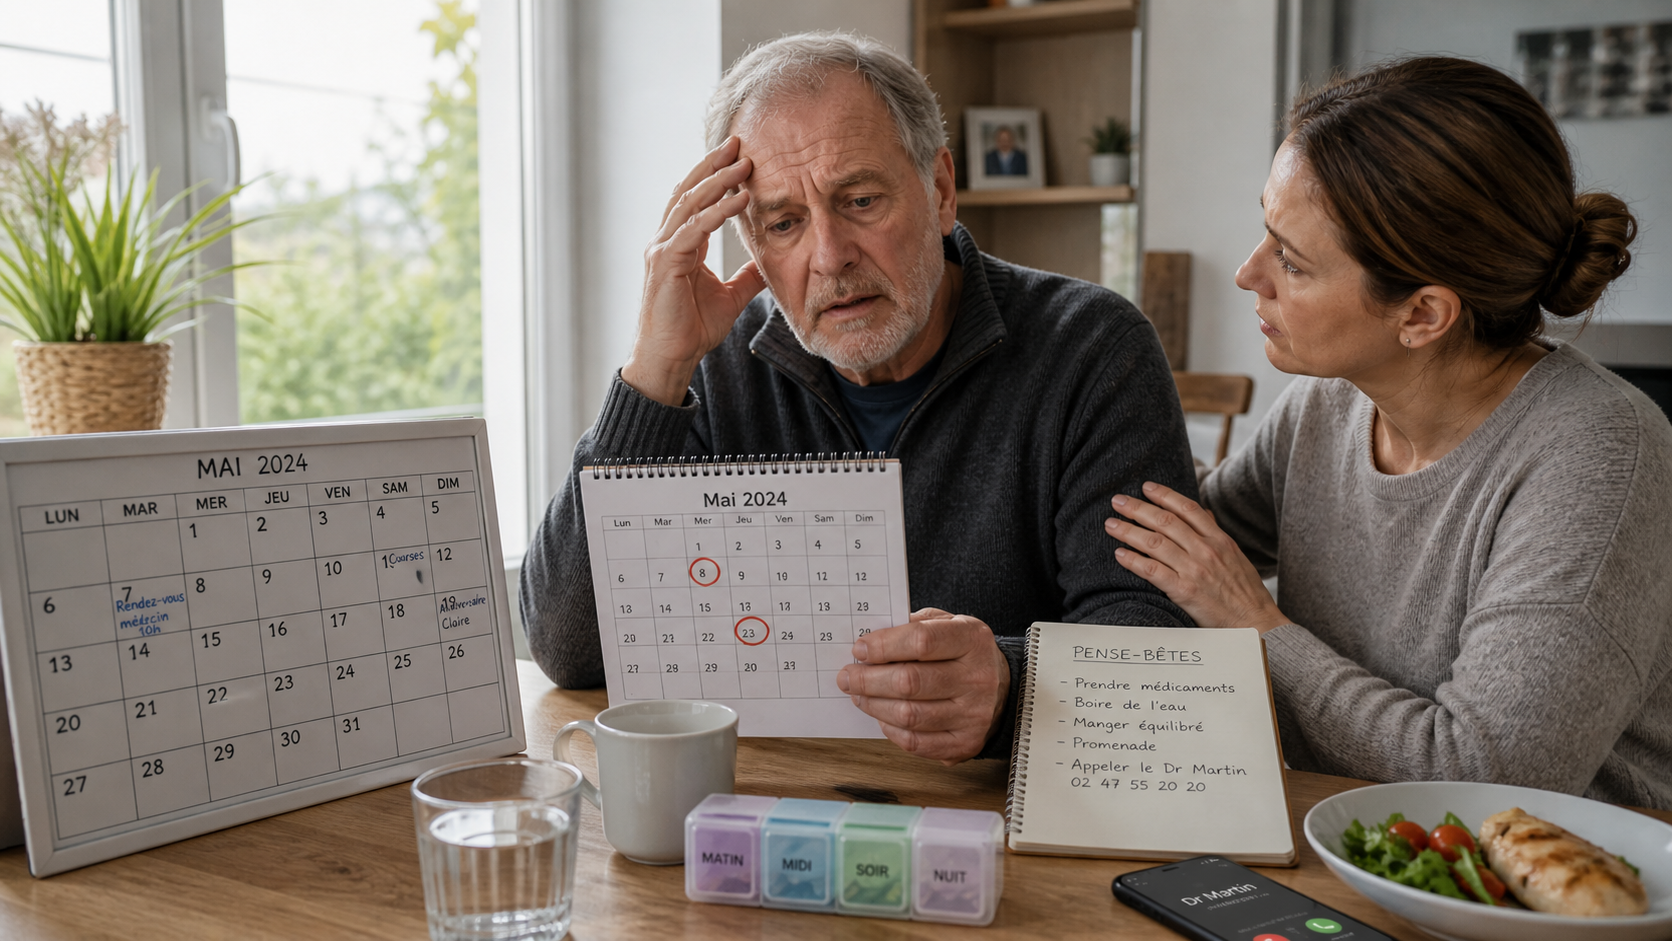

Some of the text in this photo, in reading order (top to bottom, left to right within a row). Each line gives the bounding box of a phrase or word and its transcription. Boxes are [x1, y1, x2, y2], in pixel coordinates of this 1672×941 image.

[198, 453, 308, 479] MAI 2024
[45, 477, 459, 524] LUN MAR MER JEU VEN SAM DIM
[704, 491, 787, 507] Mai 2024
[189, 501, 439, 538] 1 2 3 4 5
[775, 515, 793, 523] Ven
[814, 514, 834, 522] Sam
[856, 514, 873, 522] Dim
[696, 539, 861, 551] 1 2 3 4 5
[43, 597, 55, 614] 6
[121, 586, 133, 603] 7
[196, 578, 205, 593] 8
[262, 569, 271, 584] 9
[325, 561, 342, 576] 10
[437, 547, 452, 561] 12
[618, 574, 624, 583] 6
[658, 573, 664, 582] 7
[699, 569, 706, 577] 8
[738, 571, 744, 580] 9
[116, 593, 185, 613] Rendez-vous
[139, 625, 161, 637] 10h
[442, 616, 470, 630] Claire
[49, 655, 72, 673] 13
[129, 643, 150, 660] 14
[202, 631, 221, 648] 15
[269, 621, 287, 637] 16
[331, 612, 347, 627] 17
[388, 604, 404, 619] 18
[702, 633, 714, 642] 22
[742, 628, 756, 638] 23
[1072, 645, 1203, 663] PENSE-BÊTES
[55, 644, 464, 735] 20 21 22 23 24 25 26
[1075, 677, 1235, 693] Prendre médicaments
[1075, 697, 1186, 711] Boire de l'eau
[1074, 718, 1203, 734] Manger équilibré
[1073, 737, 1156, 751] Promenade
[62, 717, 360, 797] 27 28 29 30 31
[1071, 759, 1247, 775] Appeler le Dr Martin
[1071, 777, 1206, 792] 02 47 55 20 20
[701, 851, 745, 868] MATIN
[781, 857, 813, 873] MIDI
[855, 863, 891, 879] SOIR
[932, 869, 968, 884] NUIT
[1180, 894, 1203, 907] Dr
[1205, 881, 1258, 902] Martin
